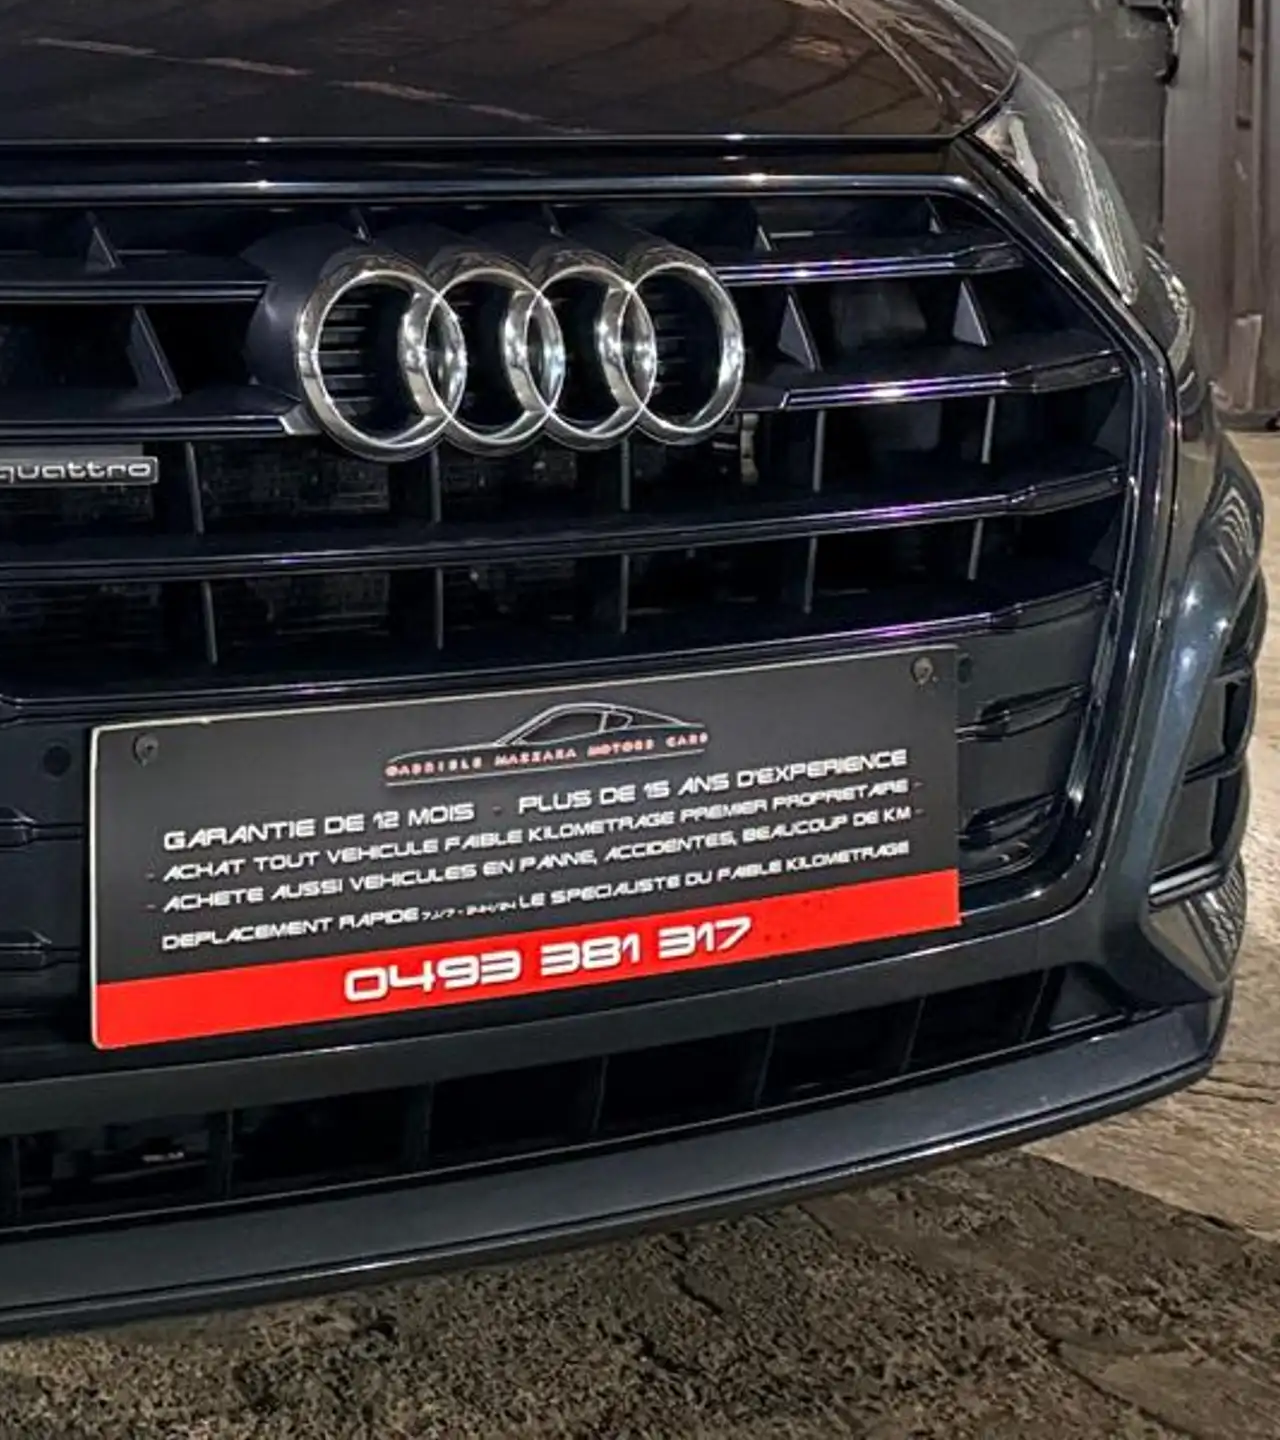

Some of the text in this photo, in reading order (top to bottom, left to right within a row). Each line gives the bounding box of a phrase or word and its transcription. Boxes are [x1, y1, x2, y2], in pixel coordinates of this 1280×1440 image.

[163, 818, 316, 851] GARANTIE
[324, 813, 365, 835] DE
[373, 810, 399, 830] 12
[408, 802, 474, 827] MOIS
[518, 789, 592, 814] PLUS
[600, 784, 636, 805] DE
[643, 779, 670, 800] 15
[678, 773, 730, 796] ANS
[737, 749, 907, 789] D'EXPERIENCE
[163, 778, 909, 883] ACHAT TOUT VEHICULE FAIBLE KILOMETRAGE PREMIER PROPRIETAIRE
[162, 917, 334, 952] DEPLACEMENT
[339, 907, 419, 931] RAPIDE
[519, 892, 545, 909] LE
[550, 873, 681, 905] SPECIALISTE
[685, 871, 713, 887] DU
[716, 859, 781, 881] FAIBLE
[786, 840, 910, 871] KILOMETRAGE
[163, 887, 264, 913] ACHETE
[270, 878, 343, 901] AUSSI
[349, 863, 477, 891] VEHICULES
[483, 859, 515, 877] EN
[742, 814, 848, 844] BEAUCOUP
[852, 811, 879, 827] DE
[883, 806, 912, 823] KM
[345, 916, 752, 1001] 0493 381 317
